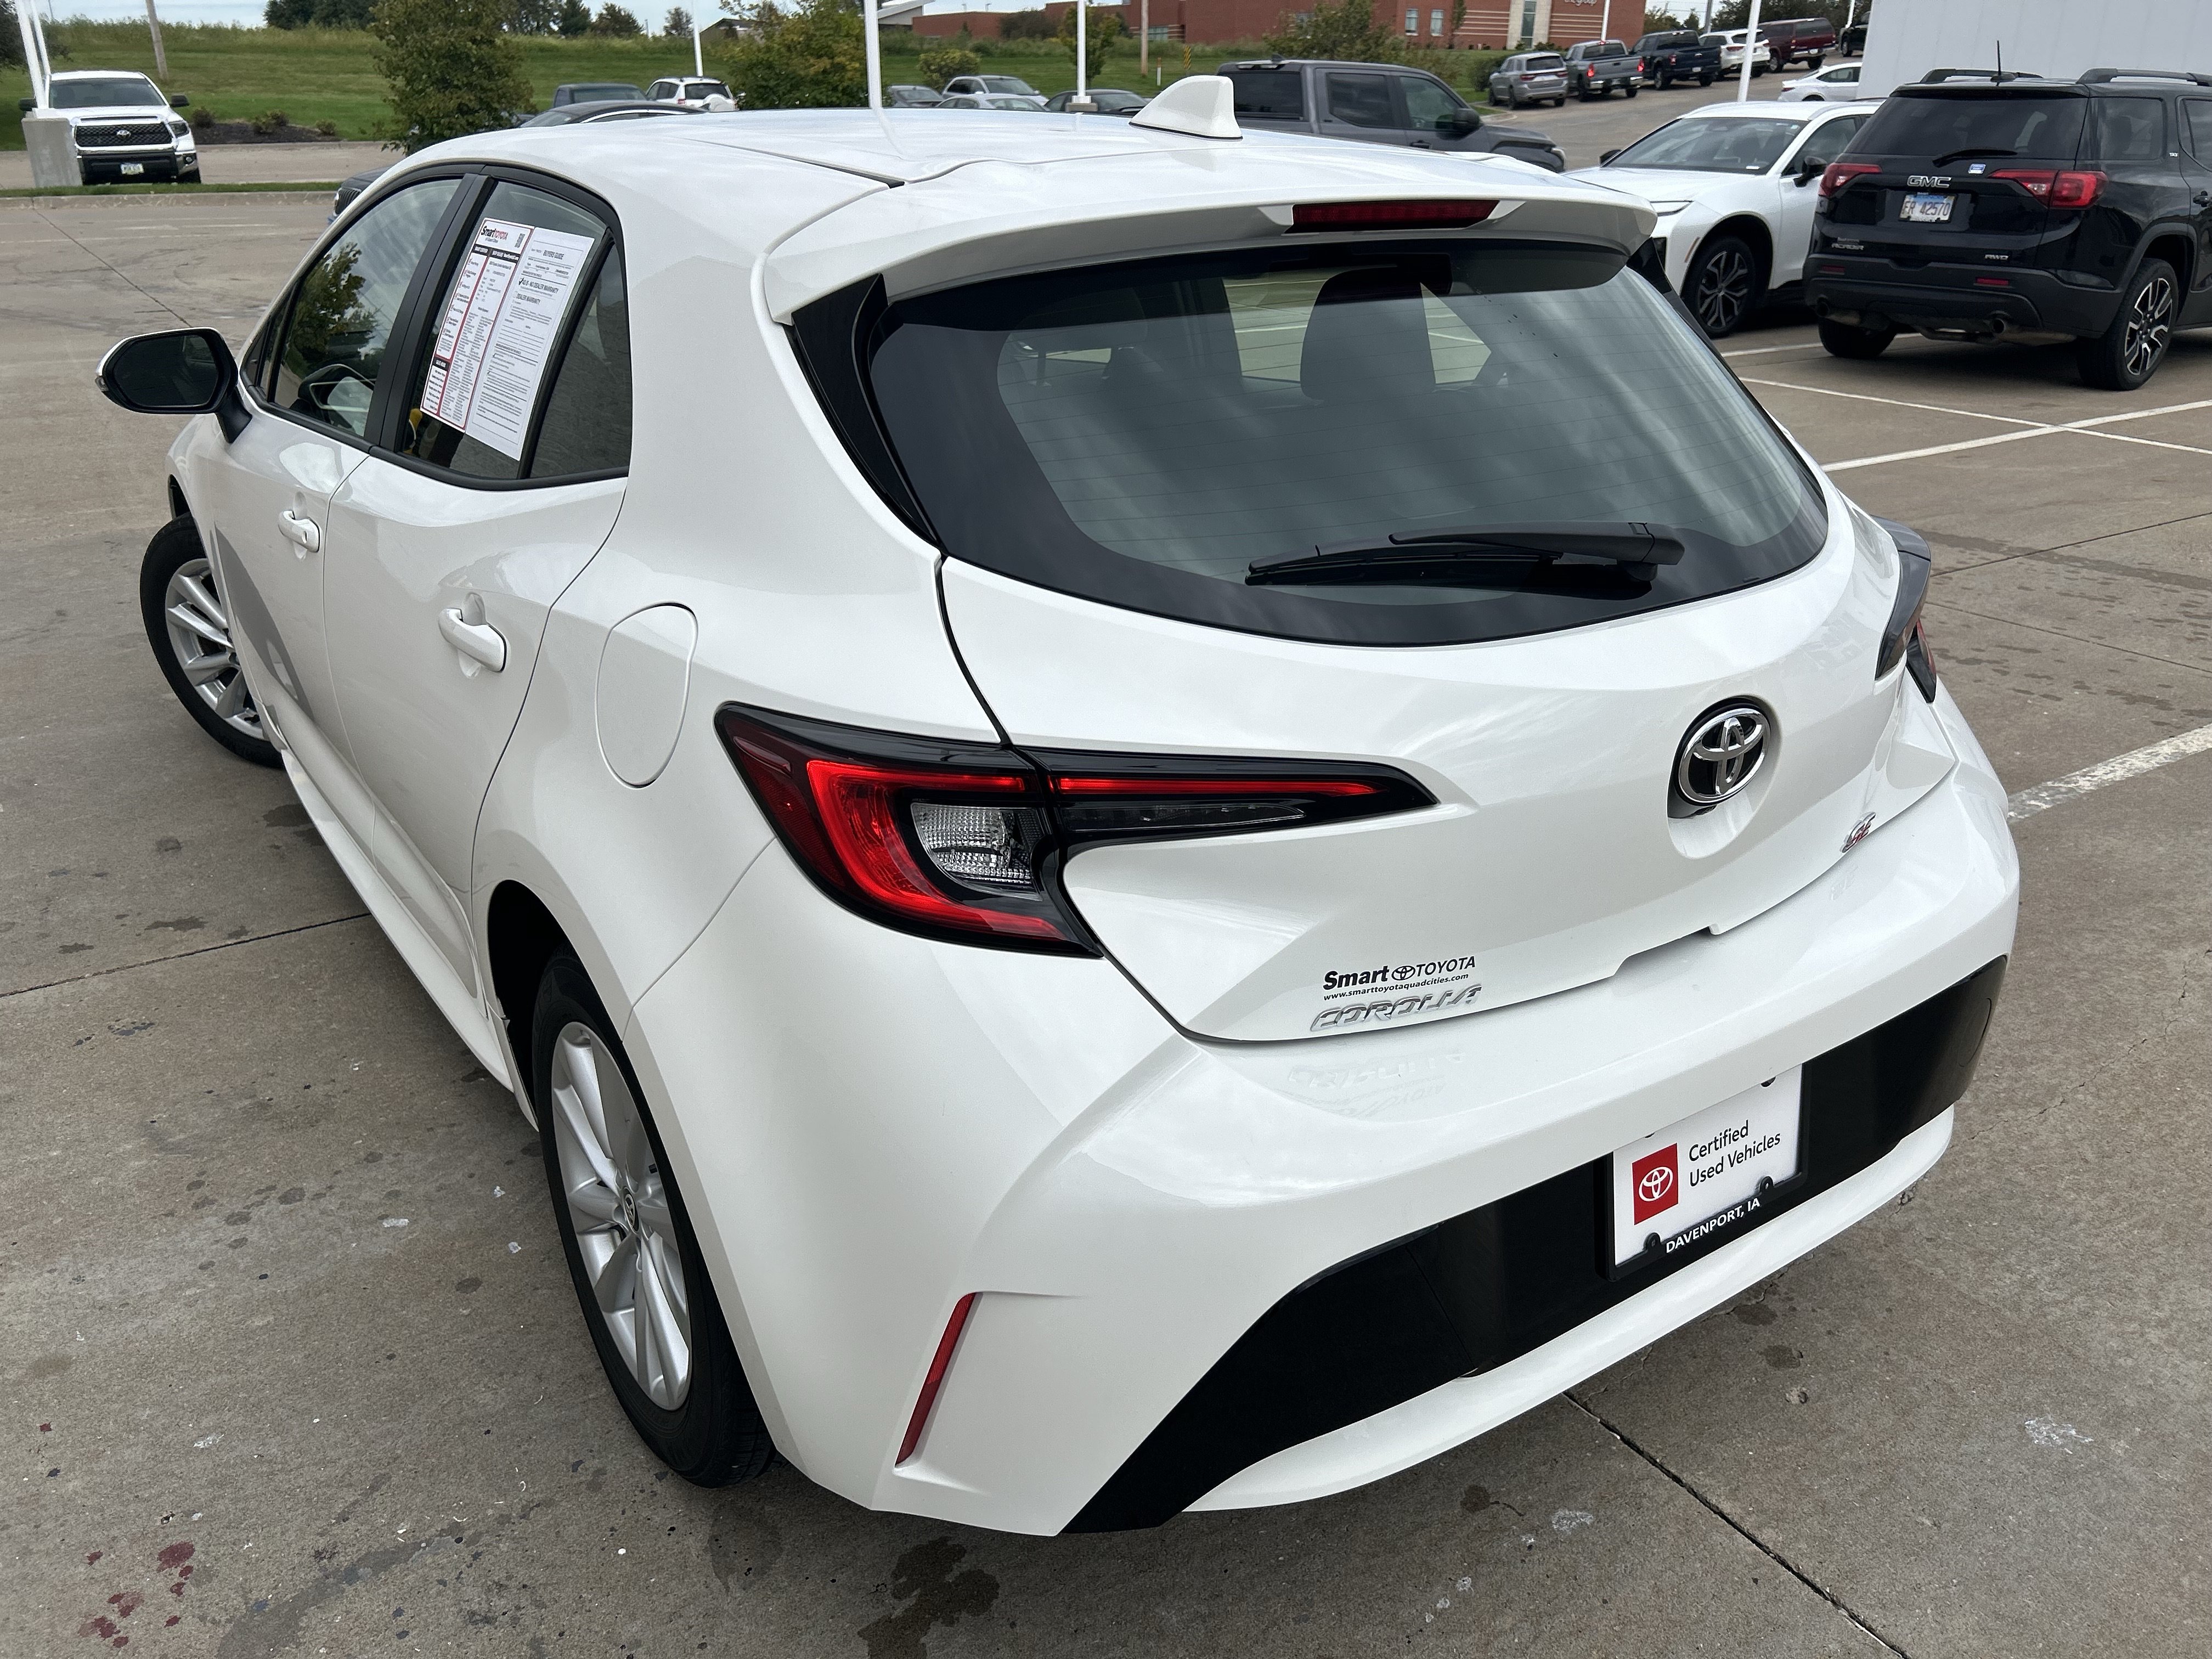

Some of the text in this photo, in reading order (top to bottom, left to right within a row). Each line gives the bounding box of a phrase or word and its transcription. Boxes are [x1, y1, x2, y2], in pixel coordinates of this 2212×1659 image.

[1906, 175, 1952, 188] GMC
[1902, 201, 1951, 216] FR 42570
[481, 226, 496, 238] Smart
[1323, 956, 1476, 990] Smart TOYOTA
[1324, 973, 1469, 1001] www.smarttoyotaquadcities.com
[1310, 983, 1483, 1031] COROLLA
[1689, 1120, 1749, 1161] Certified
[1689, 1132, 1781, 1187] Used Vehicles
[1666, 1198, 1760, 1254] DAVENPORT, IA
